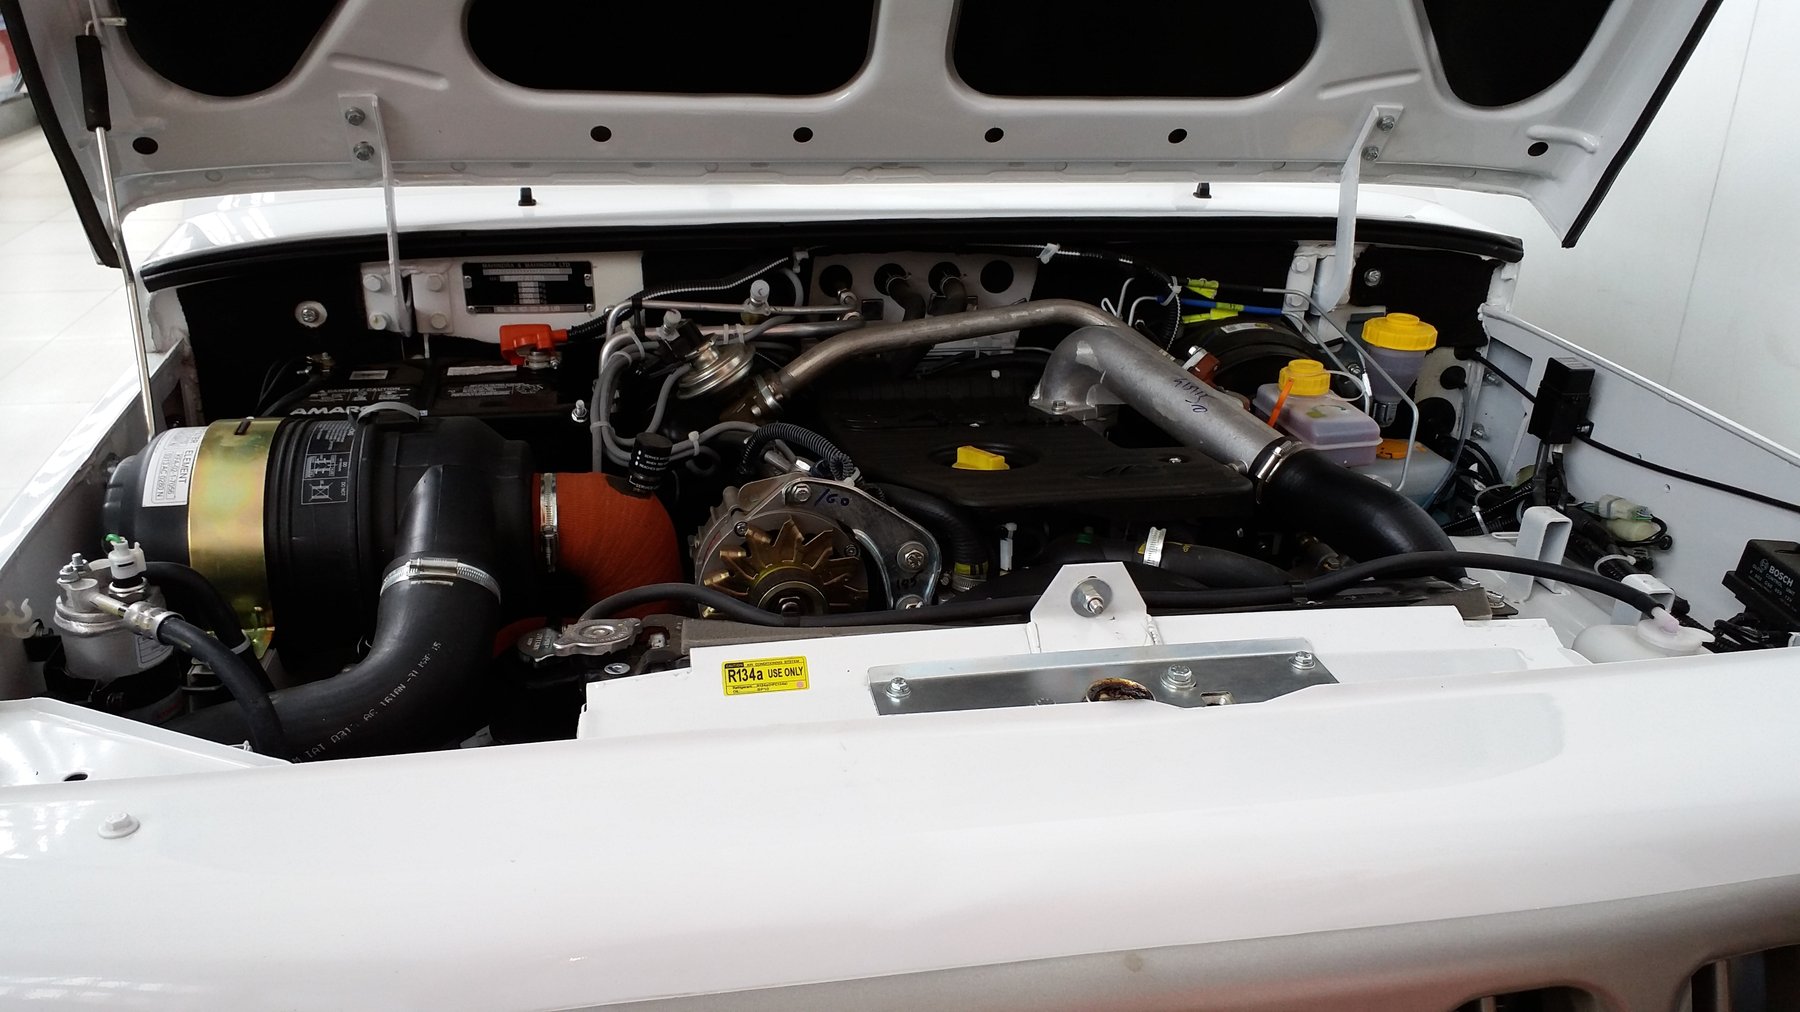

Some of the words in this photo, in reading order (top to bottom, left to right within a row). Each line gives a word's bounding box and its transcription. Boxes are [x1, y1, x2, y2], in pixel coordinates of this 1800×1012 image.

[178, 449, 194, 484] ELEMENT
[1765, 573, 1783, 588] CONTROL
[1785, 587, 1796, 596] UNIT
[1768, 565, 1794, 587] BOSCH
[727, 667, 764, 683] R134a
[767, 668, 783, 678] USE
[784, 666, 803, 677] ONLY
